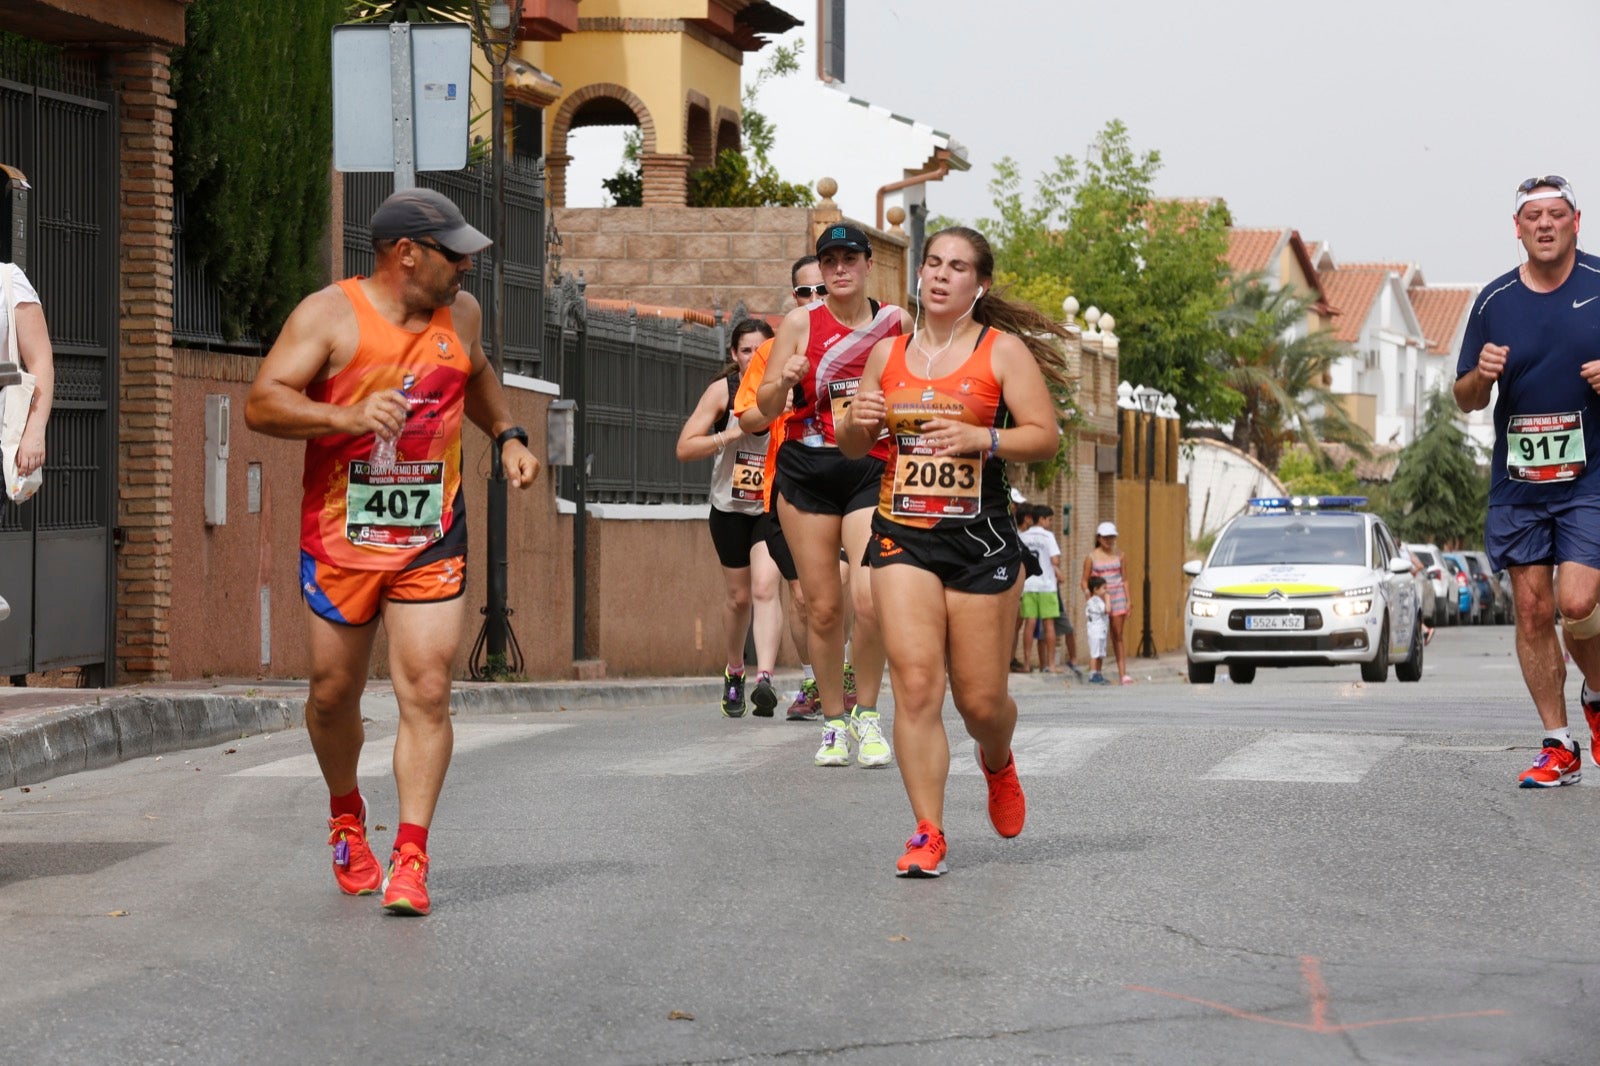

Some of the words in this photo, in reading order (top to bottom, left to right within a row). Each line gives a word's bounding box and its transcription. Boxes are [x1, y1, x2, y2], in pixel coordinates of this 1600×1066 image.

[1520, 435, 1570, 461] 917
[412, 464, 420, 474] DE
[740, 469, 765, 486] 20
[904, 461, 975, 489] 2083
[364, 489, 430, 520] 407
[1252, 617, 1277, 628] 5524
[1280, 617, 1300, 628] KSZ
